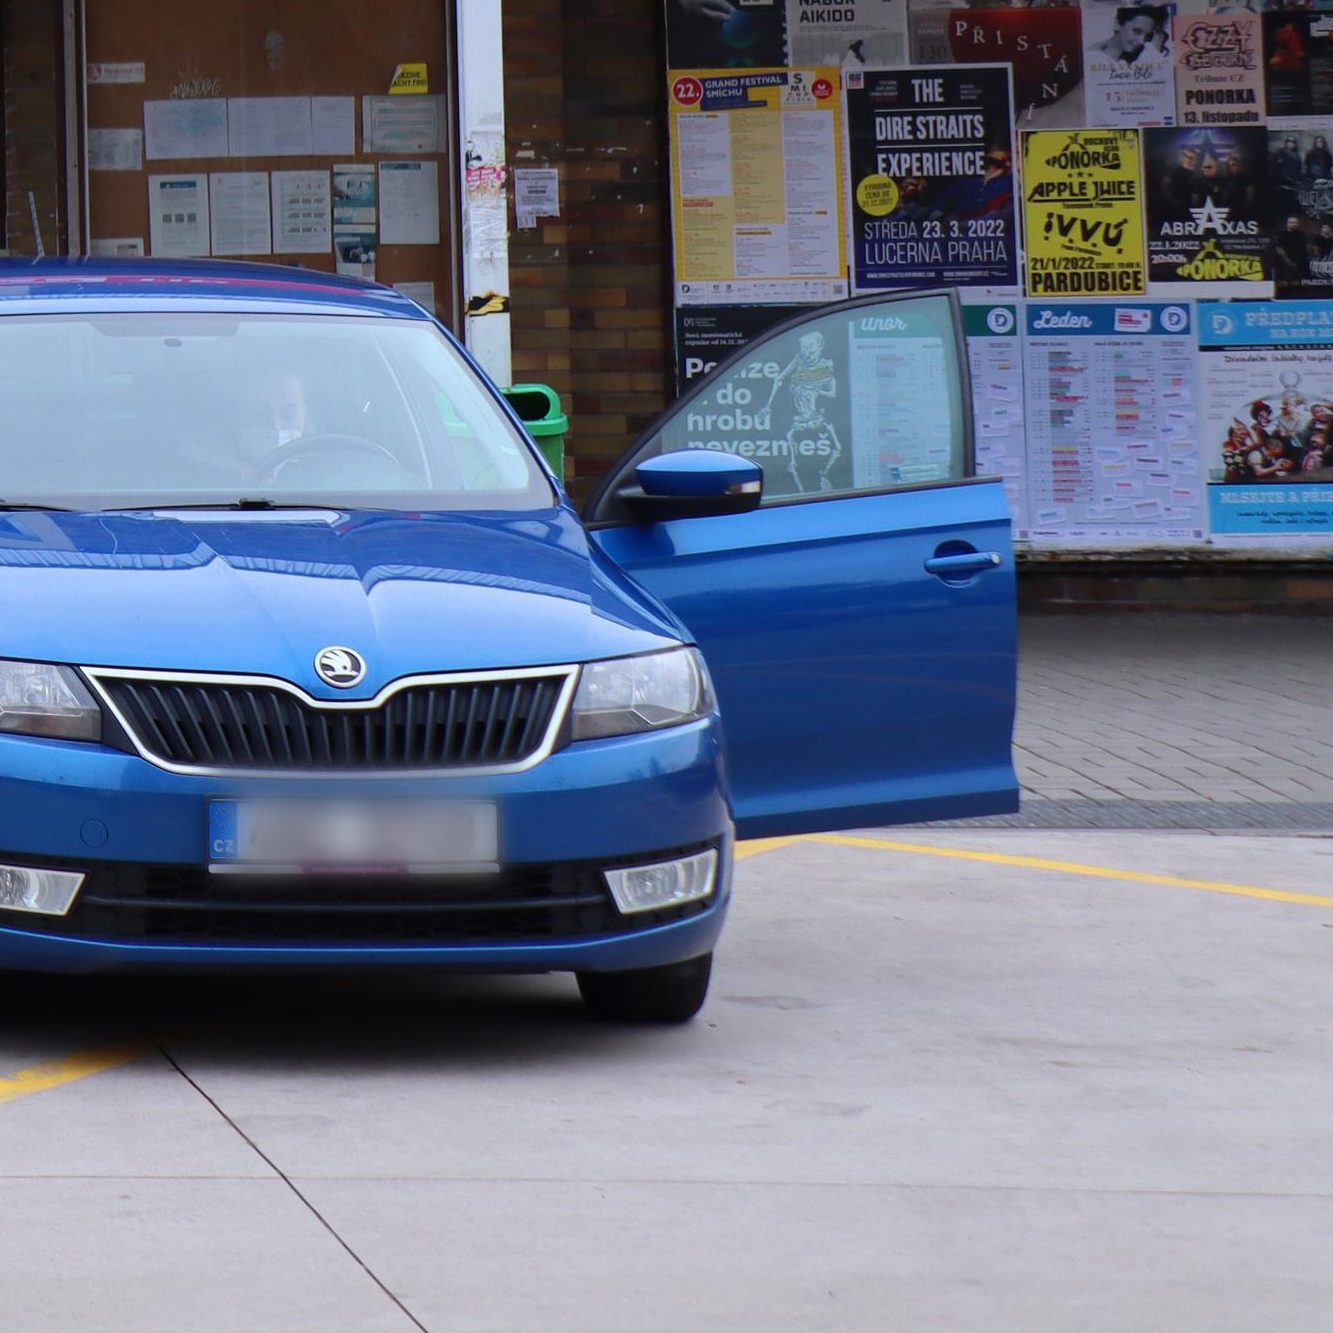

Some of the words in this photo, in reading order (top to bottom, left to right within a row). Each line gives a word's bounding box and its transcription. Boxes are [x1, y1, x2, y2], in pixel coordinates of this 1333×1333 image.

[798, 9, 856, 23] AIKIDO
[705, 79, 738, 89] GRAND
[740, 76, 782, 86] FESTIVAL
[1195, 74, 1227, 83] Tribute
[1230, 74, 1245, 82] CZ
[675, 83, 700, 99] 22.
[705, 86, 743, 99] SMÍCHU
[911, 78, 944, 104] THE
[1185, 89, 1256, 105] PONORKA
[1184, 111, 1199, 124] 13.
[1202, 110, 1259, 124] listopadu
[874, 116, 913, 141] DIRE
[916, 113, 985, 140] STRAITS
[877, 150, 986, 178] EXPERIENCE
[1027, 181, 1088, 202] APPLE
[864, 220, 918, 240] STŘEDA
[922, 221, 945, 238] 23.
[949, 220, 963, 238] 3.
[967, 220, 1005, 238] 2022
[865, 244, 942, 265] LUCERNA
[948, 242, 1008, 262] PRAHA
[1030, 257, 1095, 270] 21/1/2022
[1031, 270, 1143, 293] PARDUBICE
[1032, 309, 1093, 329] Leden
[1243, 308, 1333, 327] PŘEDPLA
[716, 382, 752, 405] do
[687, 408, 771, 431] hrobu
[213, 839, 235, 854] CZ
